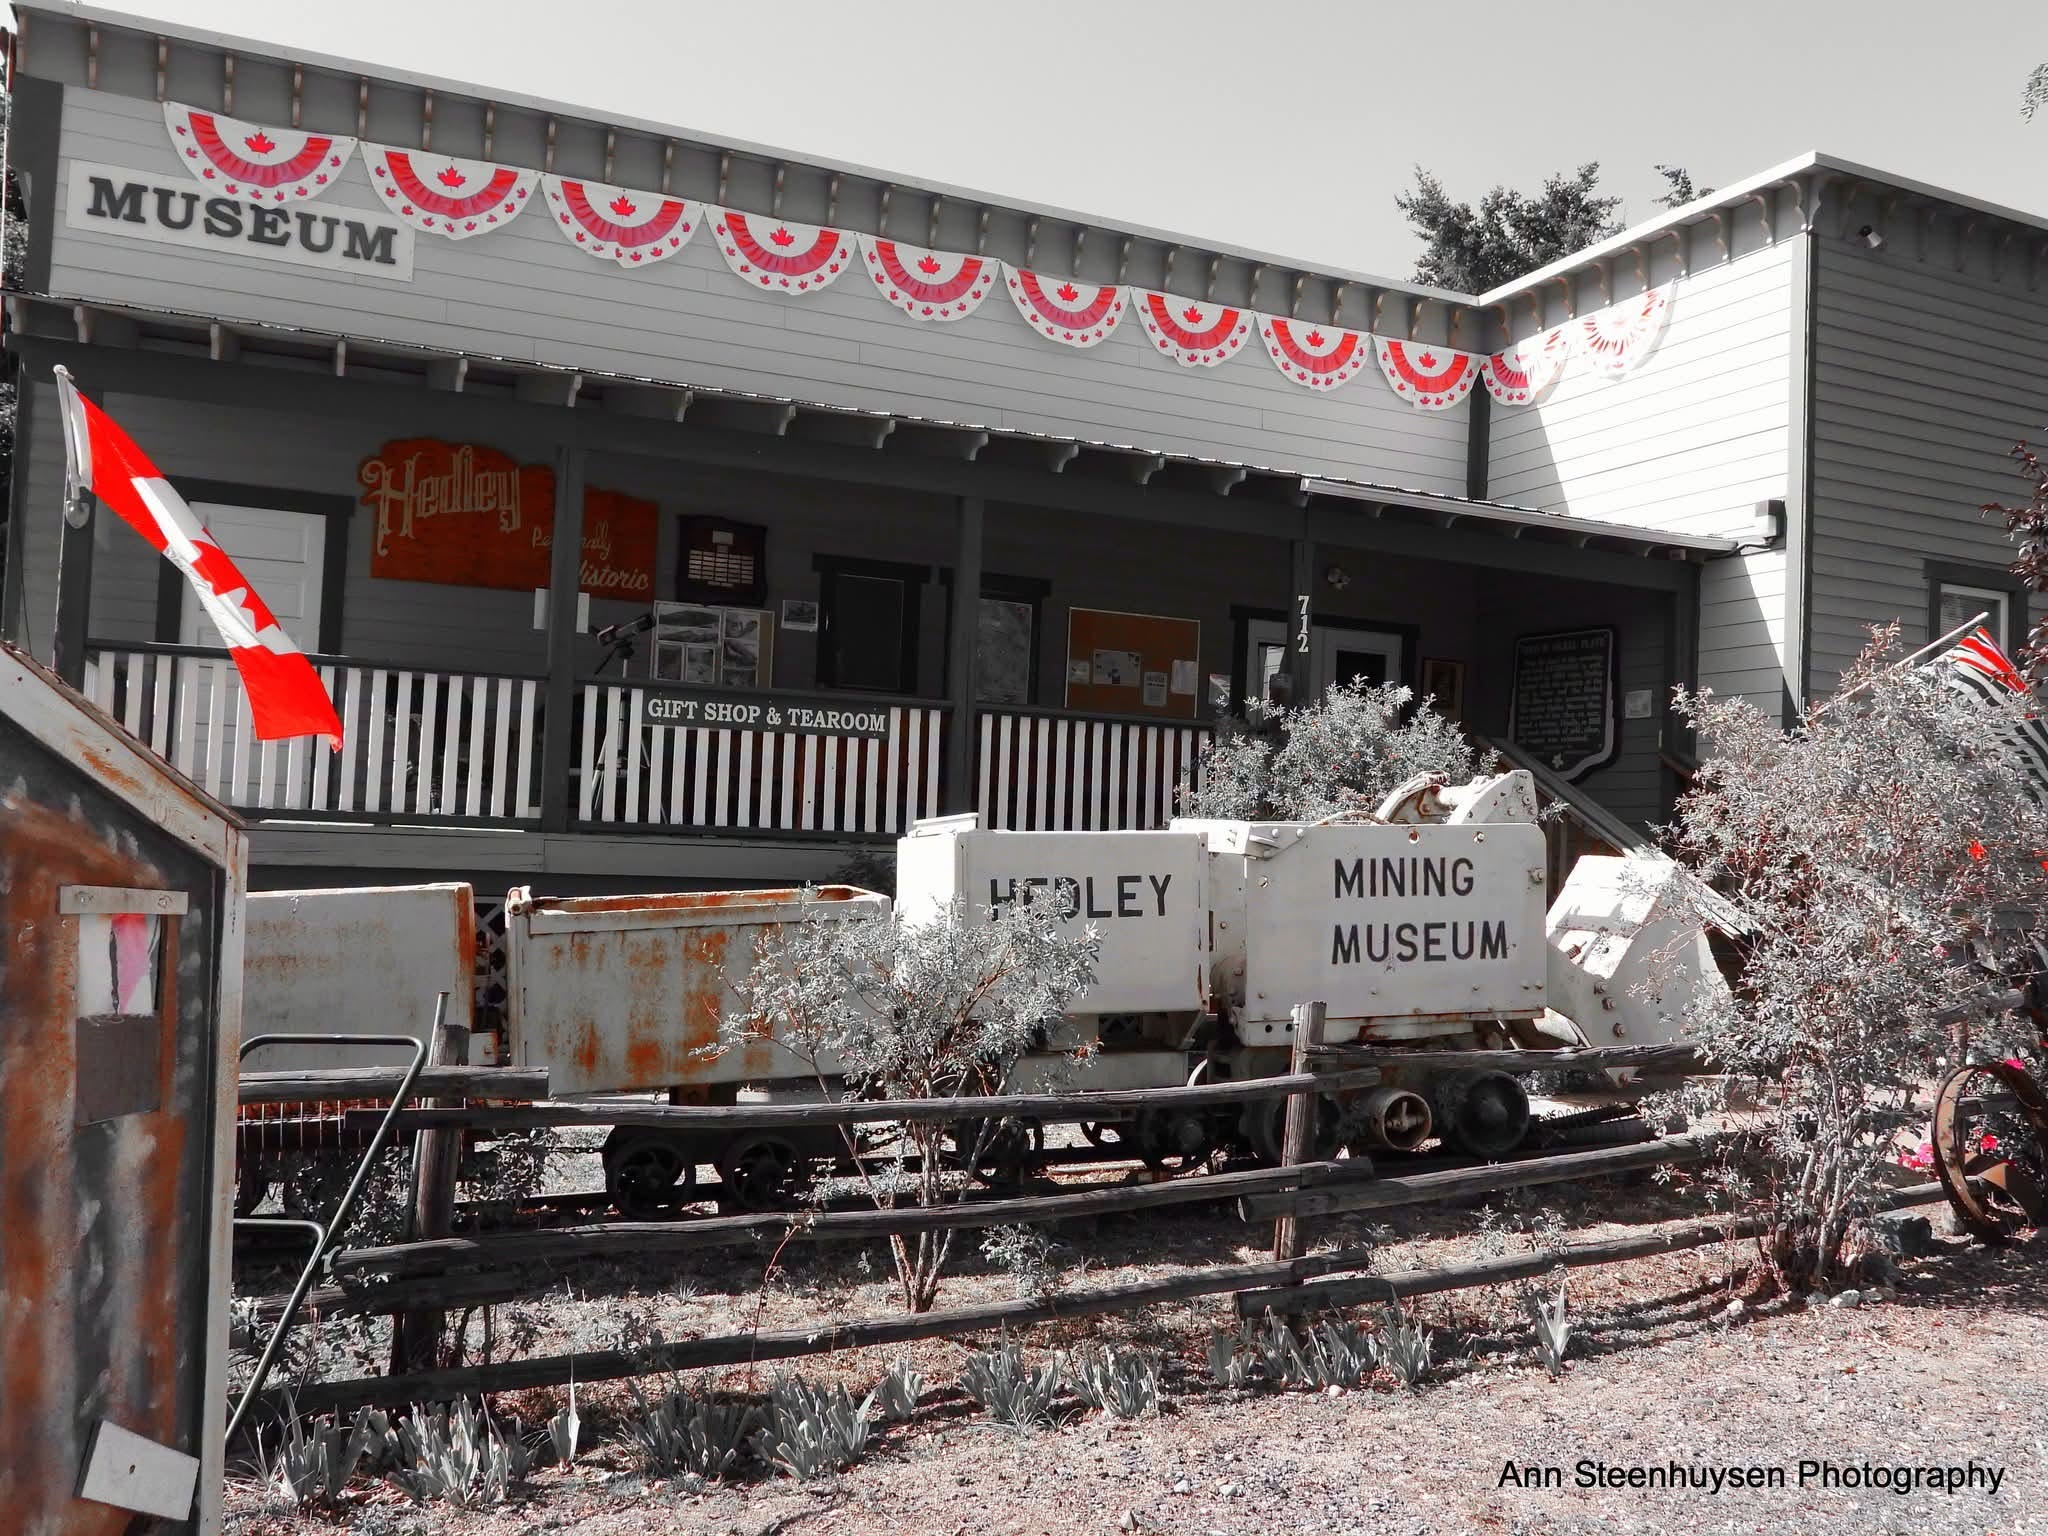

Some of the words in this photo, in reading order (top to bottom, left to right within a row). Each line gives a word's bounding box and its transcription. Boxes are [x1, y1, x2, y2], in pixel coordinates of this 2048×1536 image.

[87, 175, 399, 265] MUSEUM
[360, 445, 521, 557] Hedley
[1297, 595, 1310, 653] 712
[648, 698, 698, 720] GIFT
[704, 703, 761, 725] SHOP
[766, 707, 781, 725] &
[788, 707, 886, 732] TEAROOM
[1334, 857, 1475, 899] MINING
[1331, 920, 1508, 965] MUSEUM
